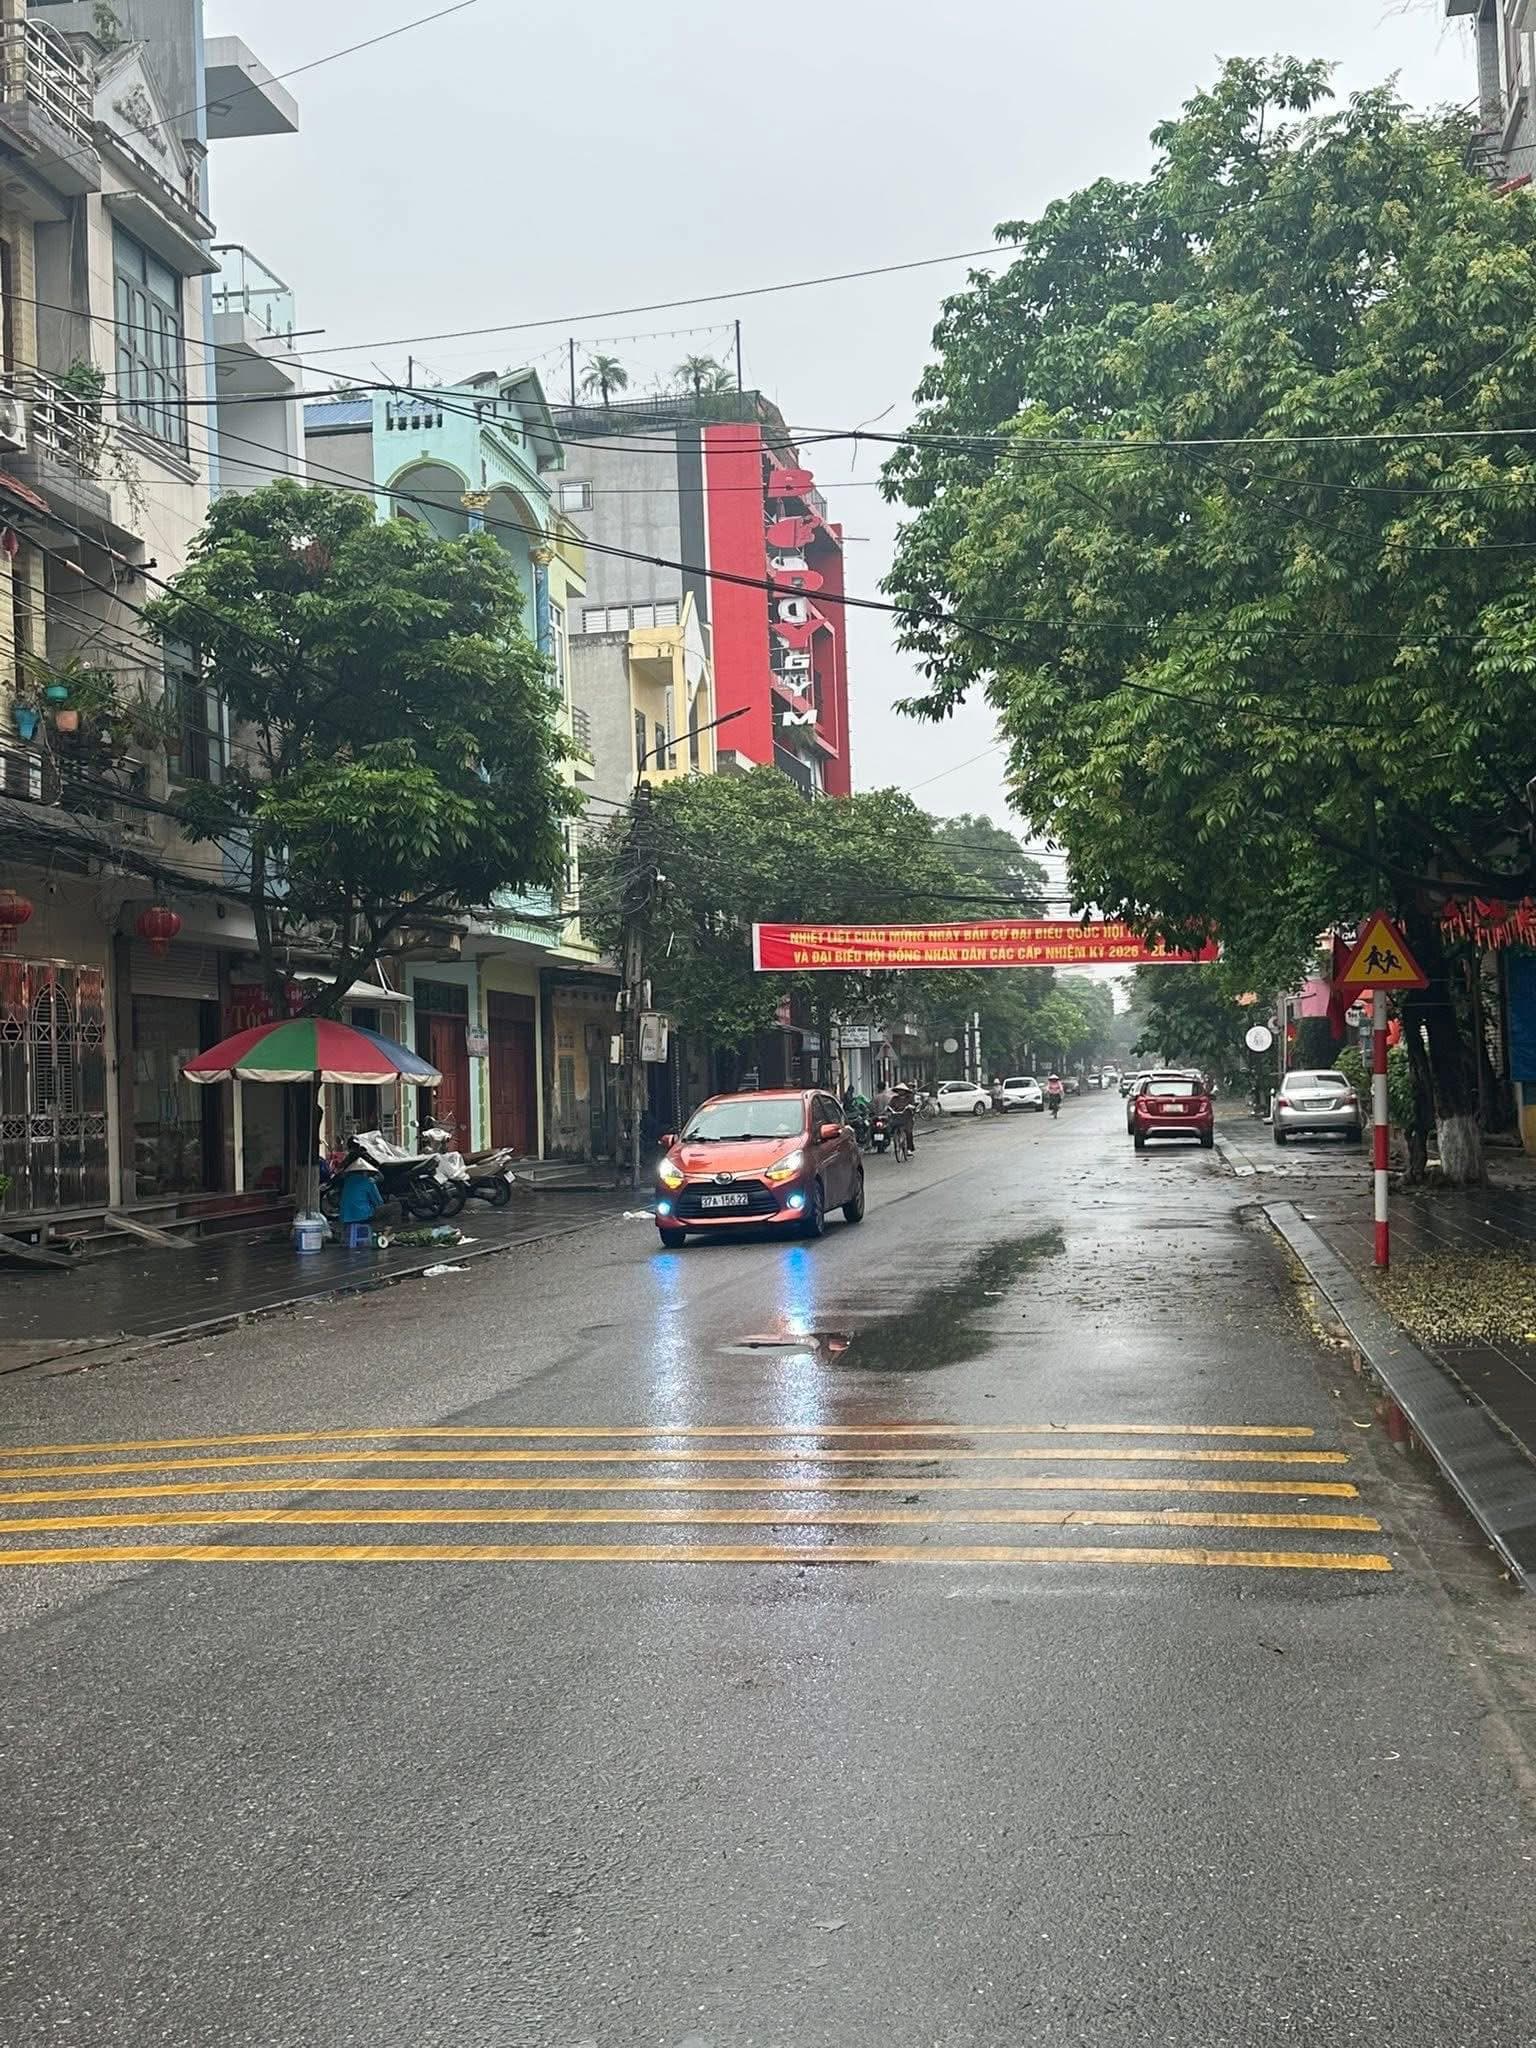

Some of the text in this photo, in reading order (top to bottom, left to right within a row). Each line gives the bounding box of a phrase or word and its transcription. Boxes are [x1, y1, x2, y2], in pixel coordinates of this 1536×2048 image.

[794, 949, 809, 963] VÀ
[812, 951, 832, 966] ĐẠI
[835, 947, 862, 963] BIỂU
[924, 947, 957, 961] NHÂN
[961, 947, 987, 960] DÂN
[989, 946, 1014, 960] CÁC
[1017, 945, 1042, 960] CẤP
[1045, 945, 1086, 961] NHIỆM
[1109, 945, 1139, 957] 2026
